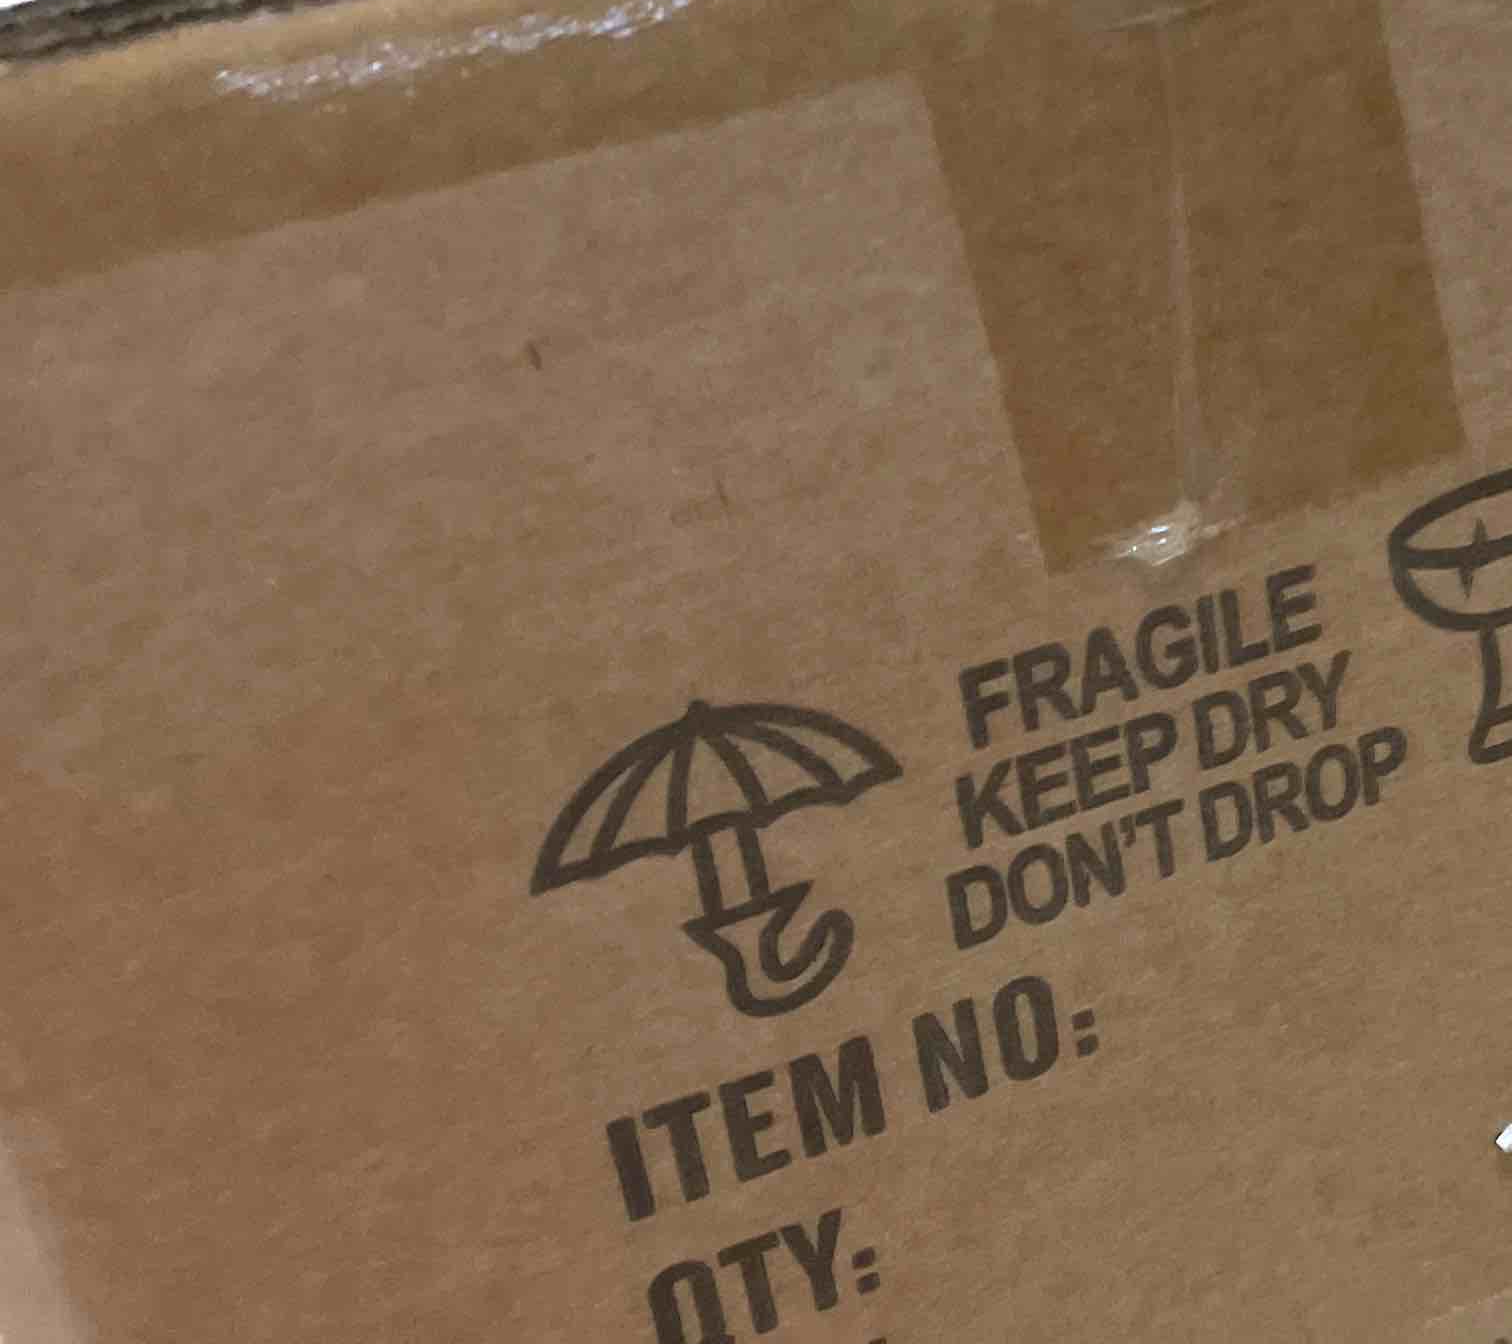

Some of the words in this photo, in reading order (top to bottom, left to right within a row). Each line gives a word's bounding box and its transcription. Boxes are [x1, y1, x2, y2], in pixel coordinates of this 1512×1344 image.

[955, 711, 1177, 848] KEEP
[1194, 651, 1352, 768] DRY
[958, 564, 1322, 749] FRAGILE
[946, 800, 1184, 950] DON'T
[1200, 725, 1408, 862] DROP
[605, 1035, 889, 1221] ITEM
[911, 976, 1100, 1113] NO:
